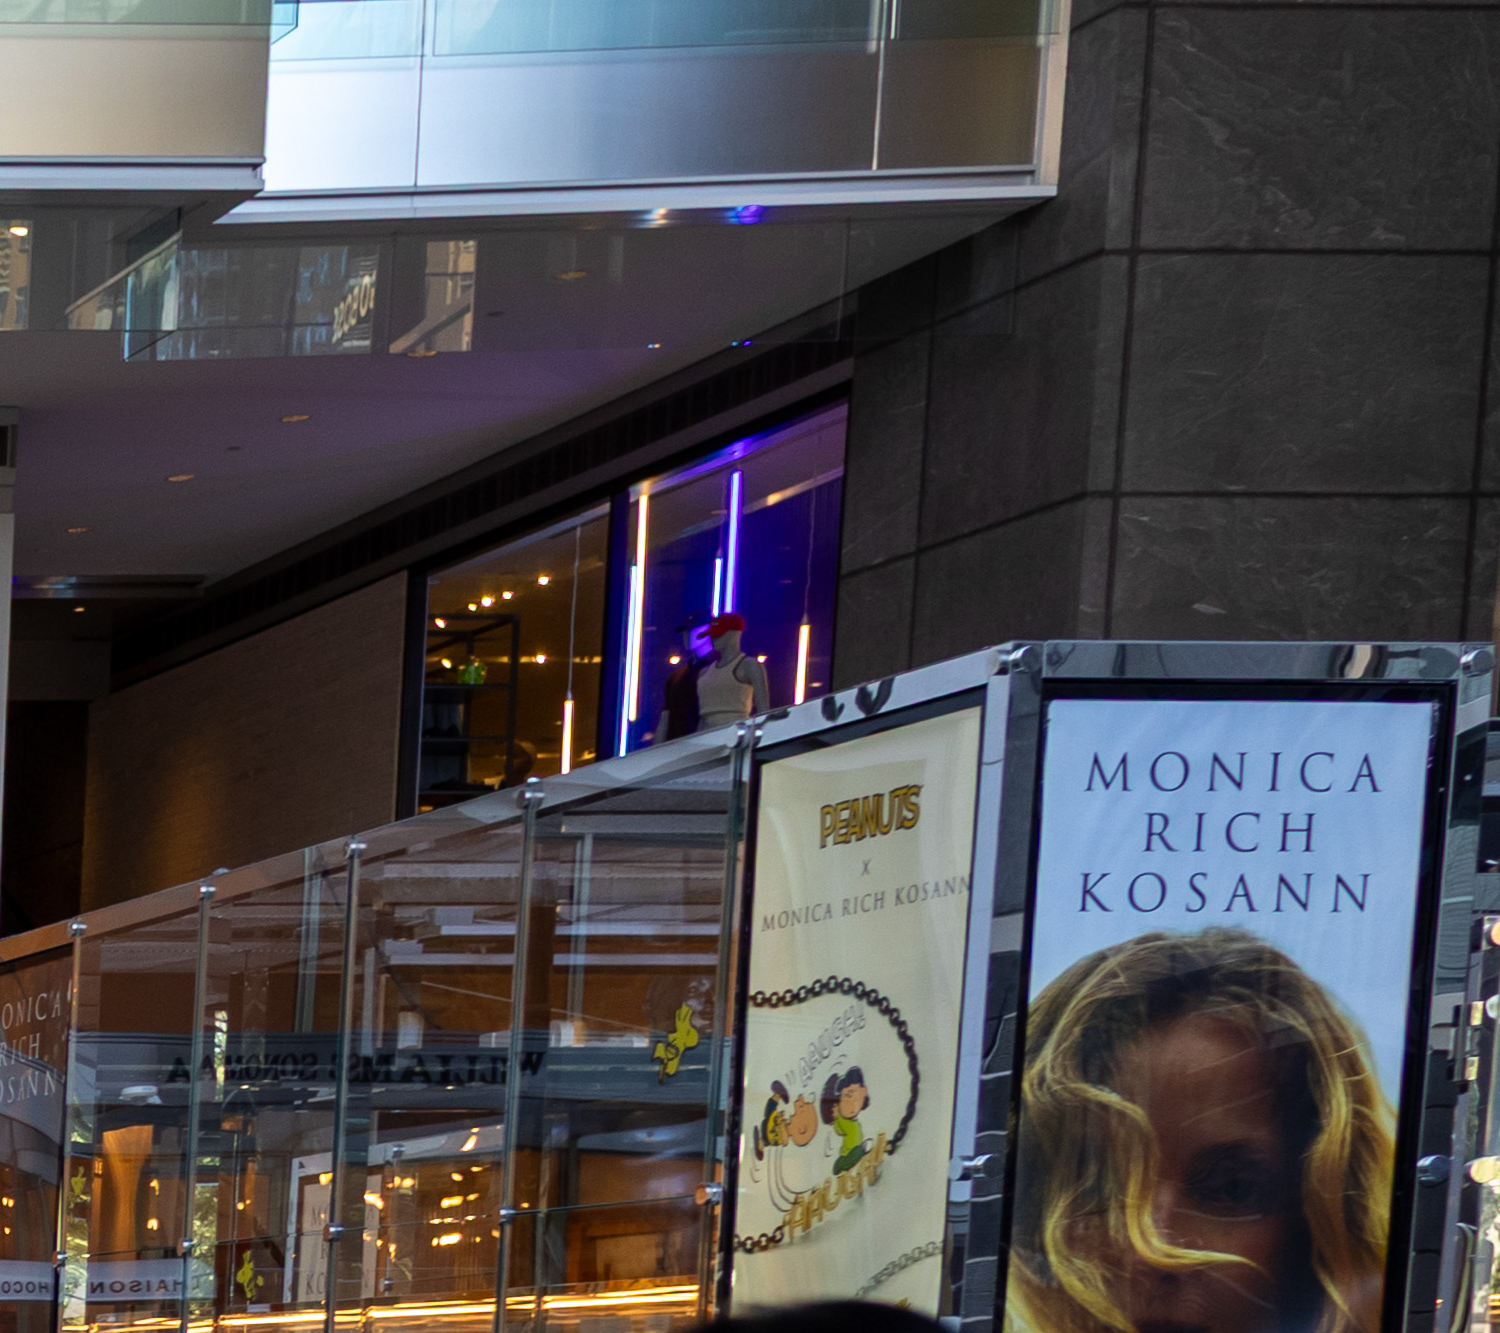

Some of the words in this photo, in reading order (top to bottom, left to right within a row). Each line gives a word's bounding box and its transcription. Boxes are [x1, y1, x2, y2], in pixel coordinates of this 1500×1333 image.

[1085, 750, 1382, 793] MONICA
[819, 783, 923, 850] PEANUTS
[1144, 812, 1318, 853] RICH
[761, 904, 834, 933] MONICA
[841, 889, 886, 917] RICH
[894, 873, 971, 908] KOSANN
[1080, 871, 1373, 914] KOSANN
